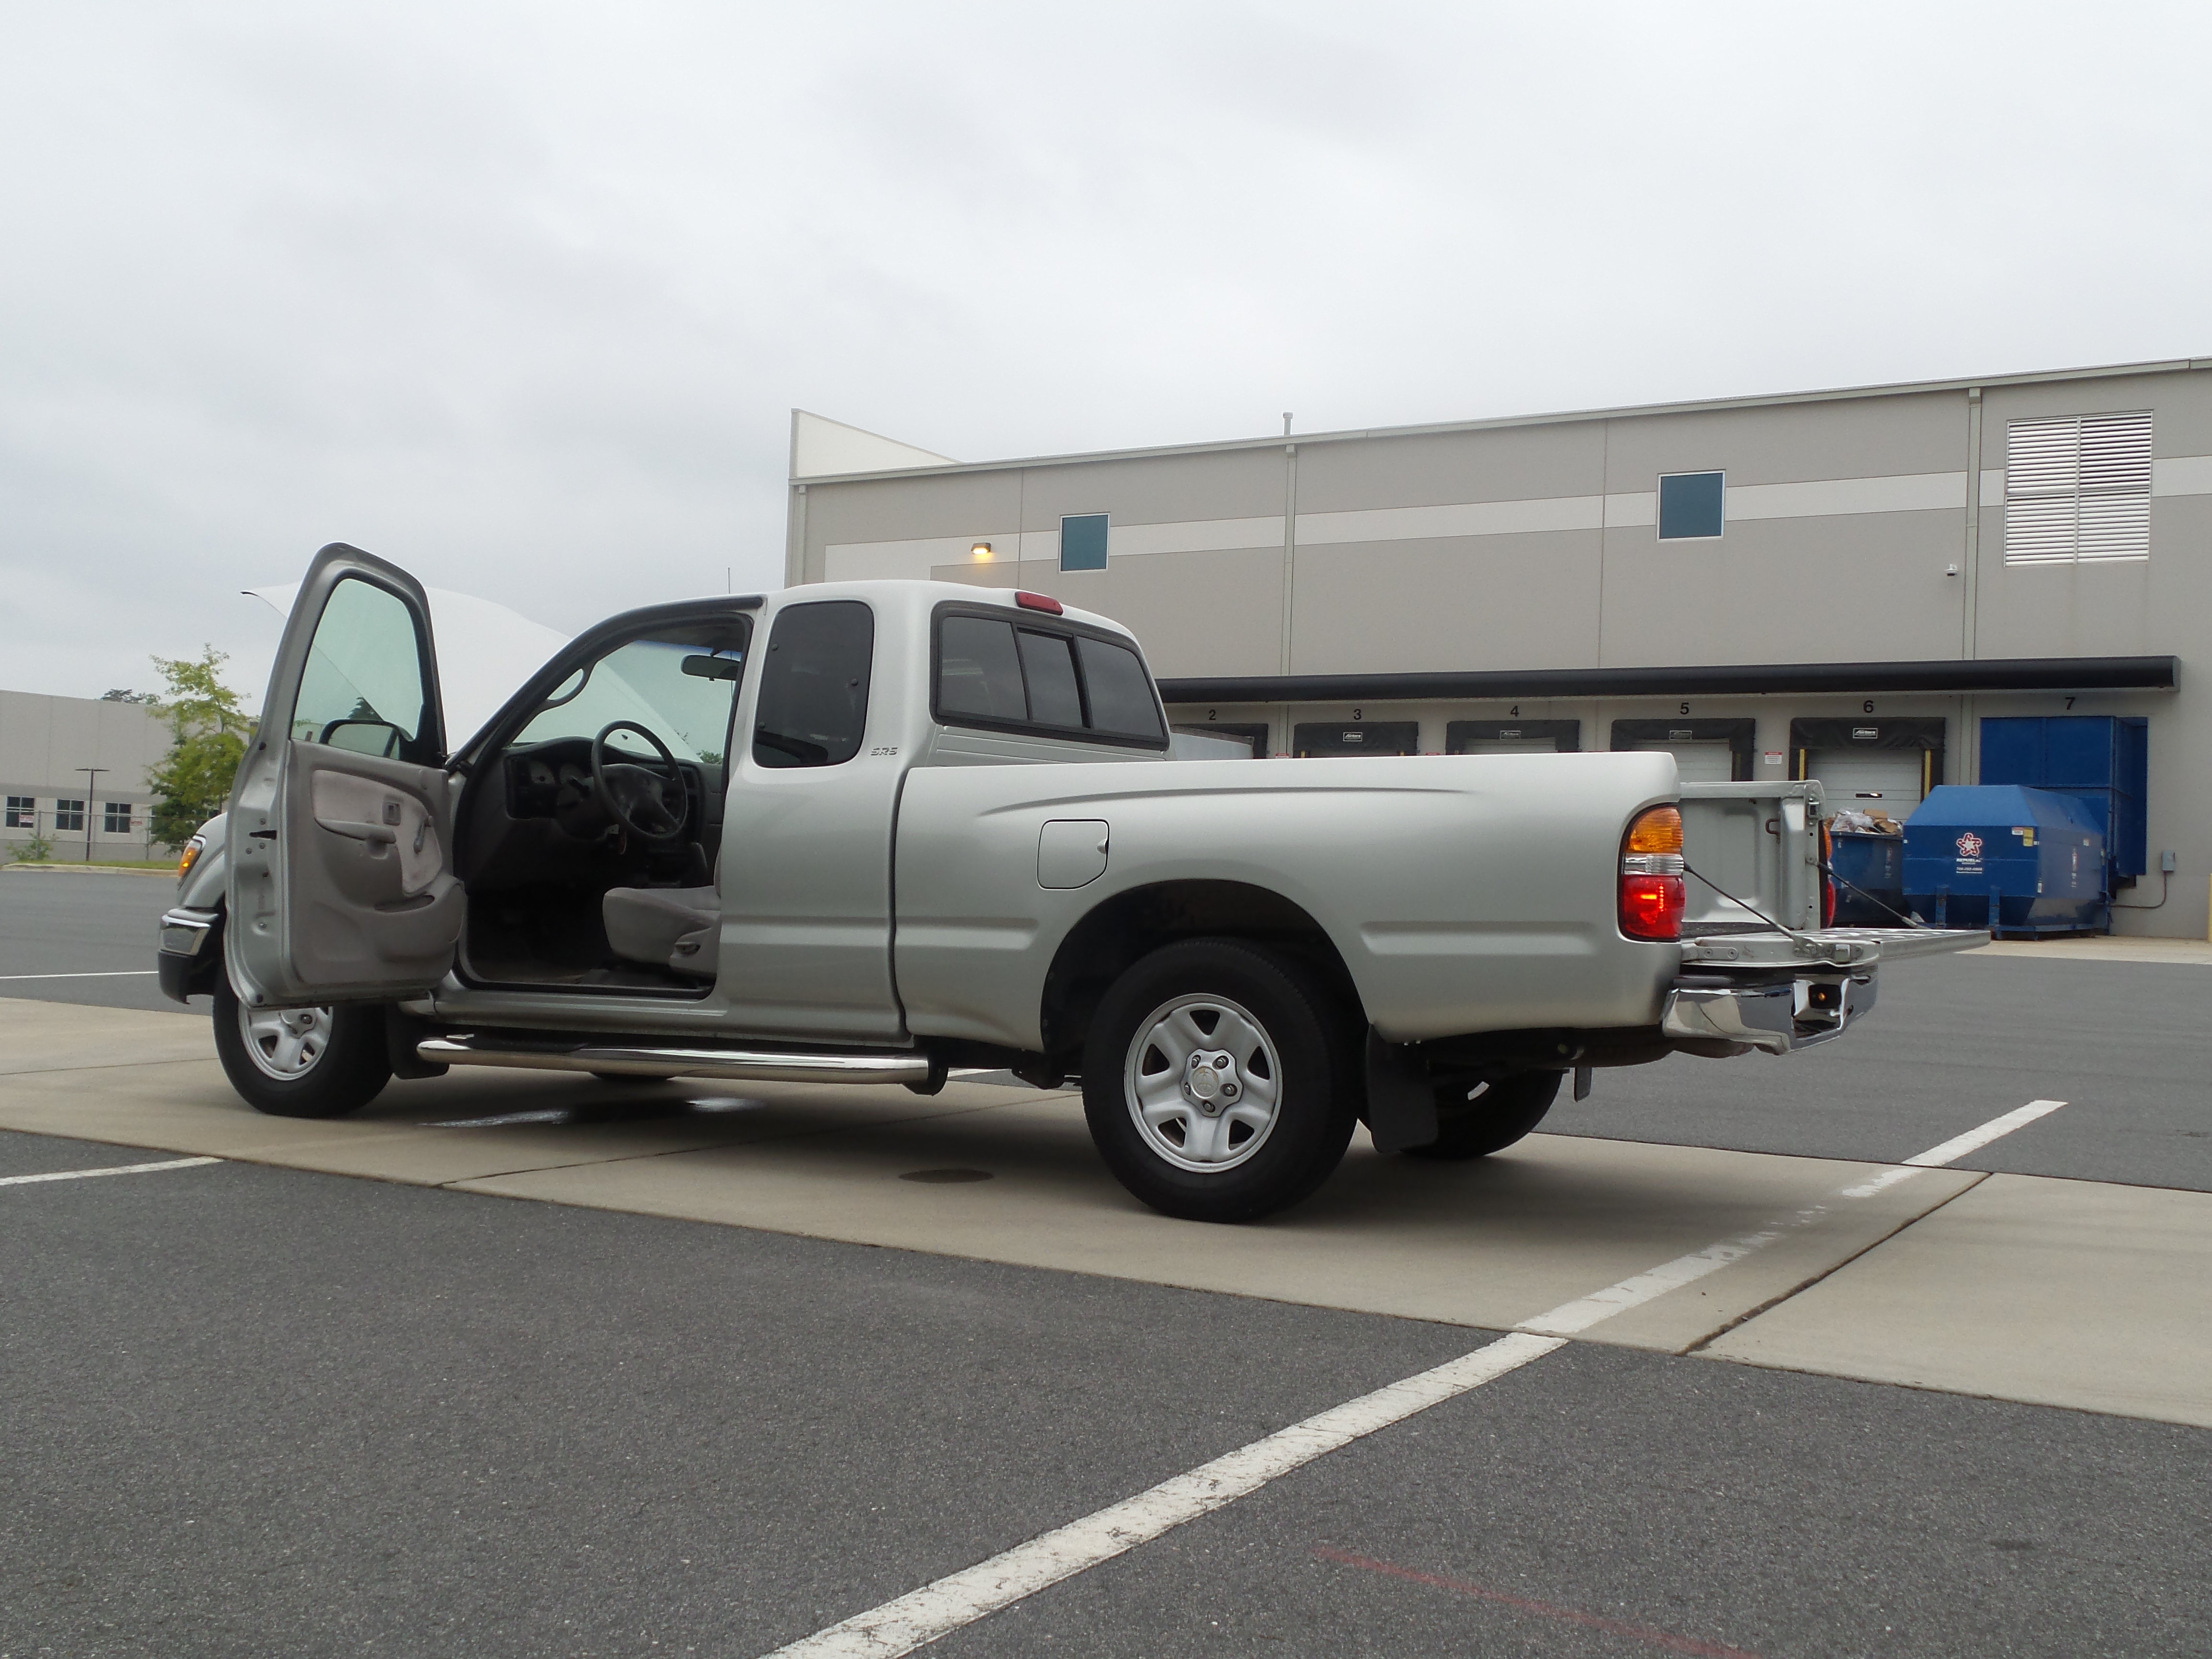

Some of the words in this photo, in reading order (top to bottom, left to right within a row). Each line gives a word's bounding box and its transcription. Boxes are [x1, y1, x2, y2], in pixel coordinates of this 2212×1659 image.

[1680, 702, 1689, 715] 5
[1863, 700, 1874, 713] 6
[2065, 697, 2076, 710] 7
[1209, 709, 1216, 721] 2
[1354, 709, 1361, 720] 3
[1510, 706, 1519, 717] 4
[870, 747, 899, 756] SR5
